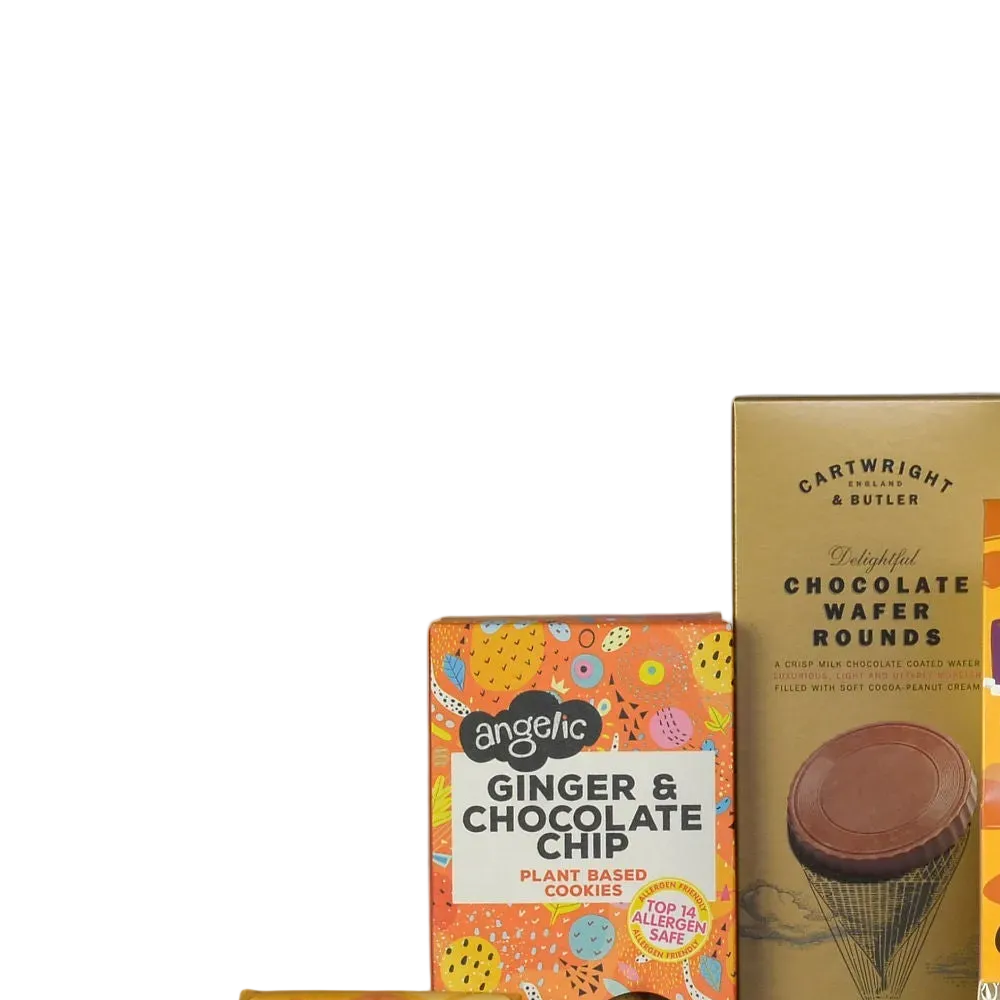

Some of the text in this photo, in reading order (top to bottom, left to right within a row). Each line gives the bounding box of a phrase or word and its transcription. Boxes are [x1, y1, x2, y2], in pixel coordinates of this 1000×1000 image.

[799, 458, 953, 493] CARTWRIGHT
[832, 494, 918, 505] & BUTLER
[828, 544, 921, 574] Delightful
[784, 576, 969, 595] CHOCOLATE
[824, 603, 930, 621] WAFER
[813, 628, 942, 647] ROUNDS
[774, 660, 980, 668] A CRISP MILK CHOCOLATE COATED WAFER
[774, 684, 807, 692] FILLED
[811, 684, 836, 692] WITH
[840, 684, 863, 692] SOFT
[948, 684, 980, 692] CREAM
[475, 711, 587, 758] angelic
[487, 774, 677, 801] GINGER &
[462, 804, 702, 833] CHOCOLATE
[537, 832, 629, 860] CHIP
[520, 868, 647, 882] PLANT BASED
[545, 884, 623, 897] COOKIES
[639, 881, 707, 911] ALLERGEN FRIENDLY
[647, 899, 696, 919] TOP 14
[632, 911, 707, 934] ALLERGEN
[633, 929, 699, 959] ALLERGEN FRIENDLY
[649, 928, 685, 945] SAFE
